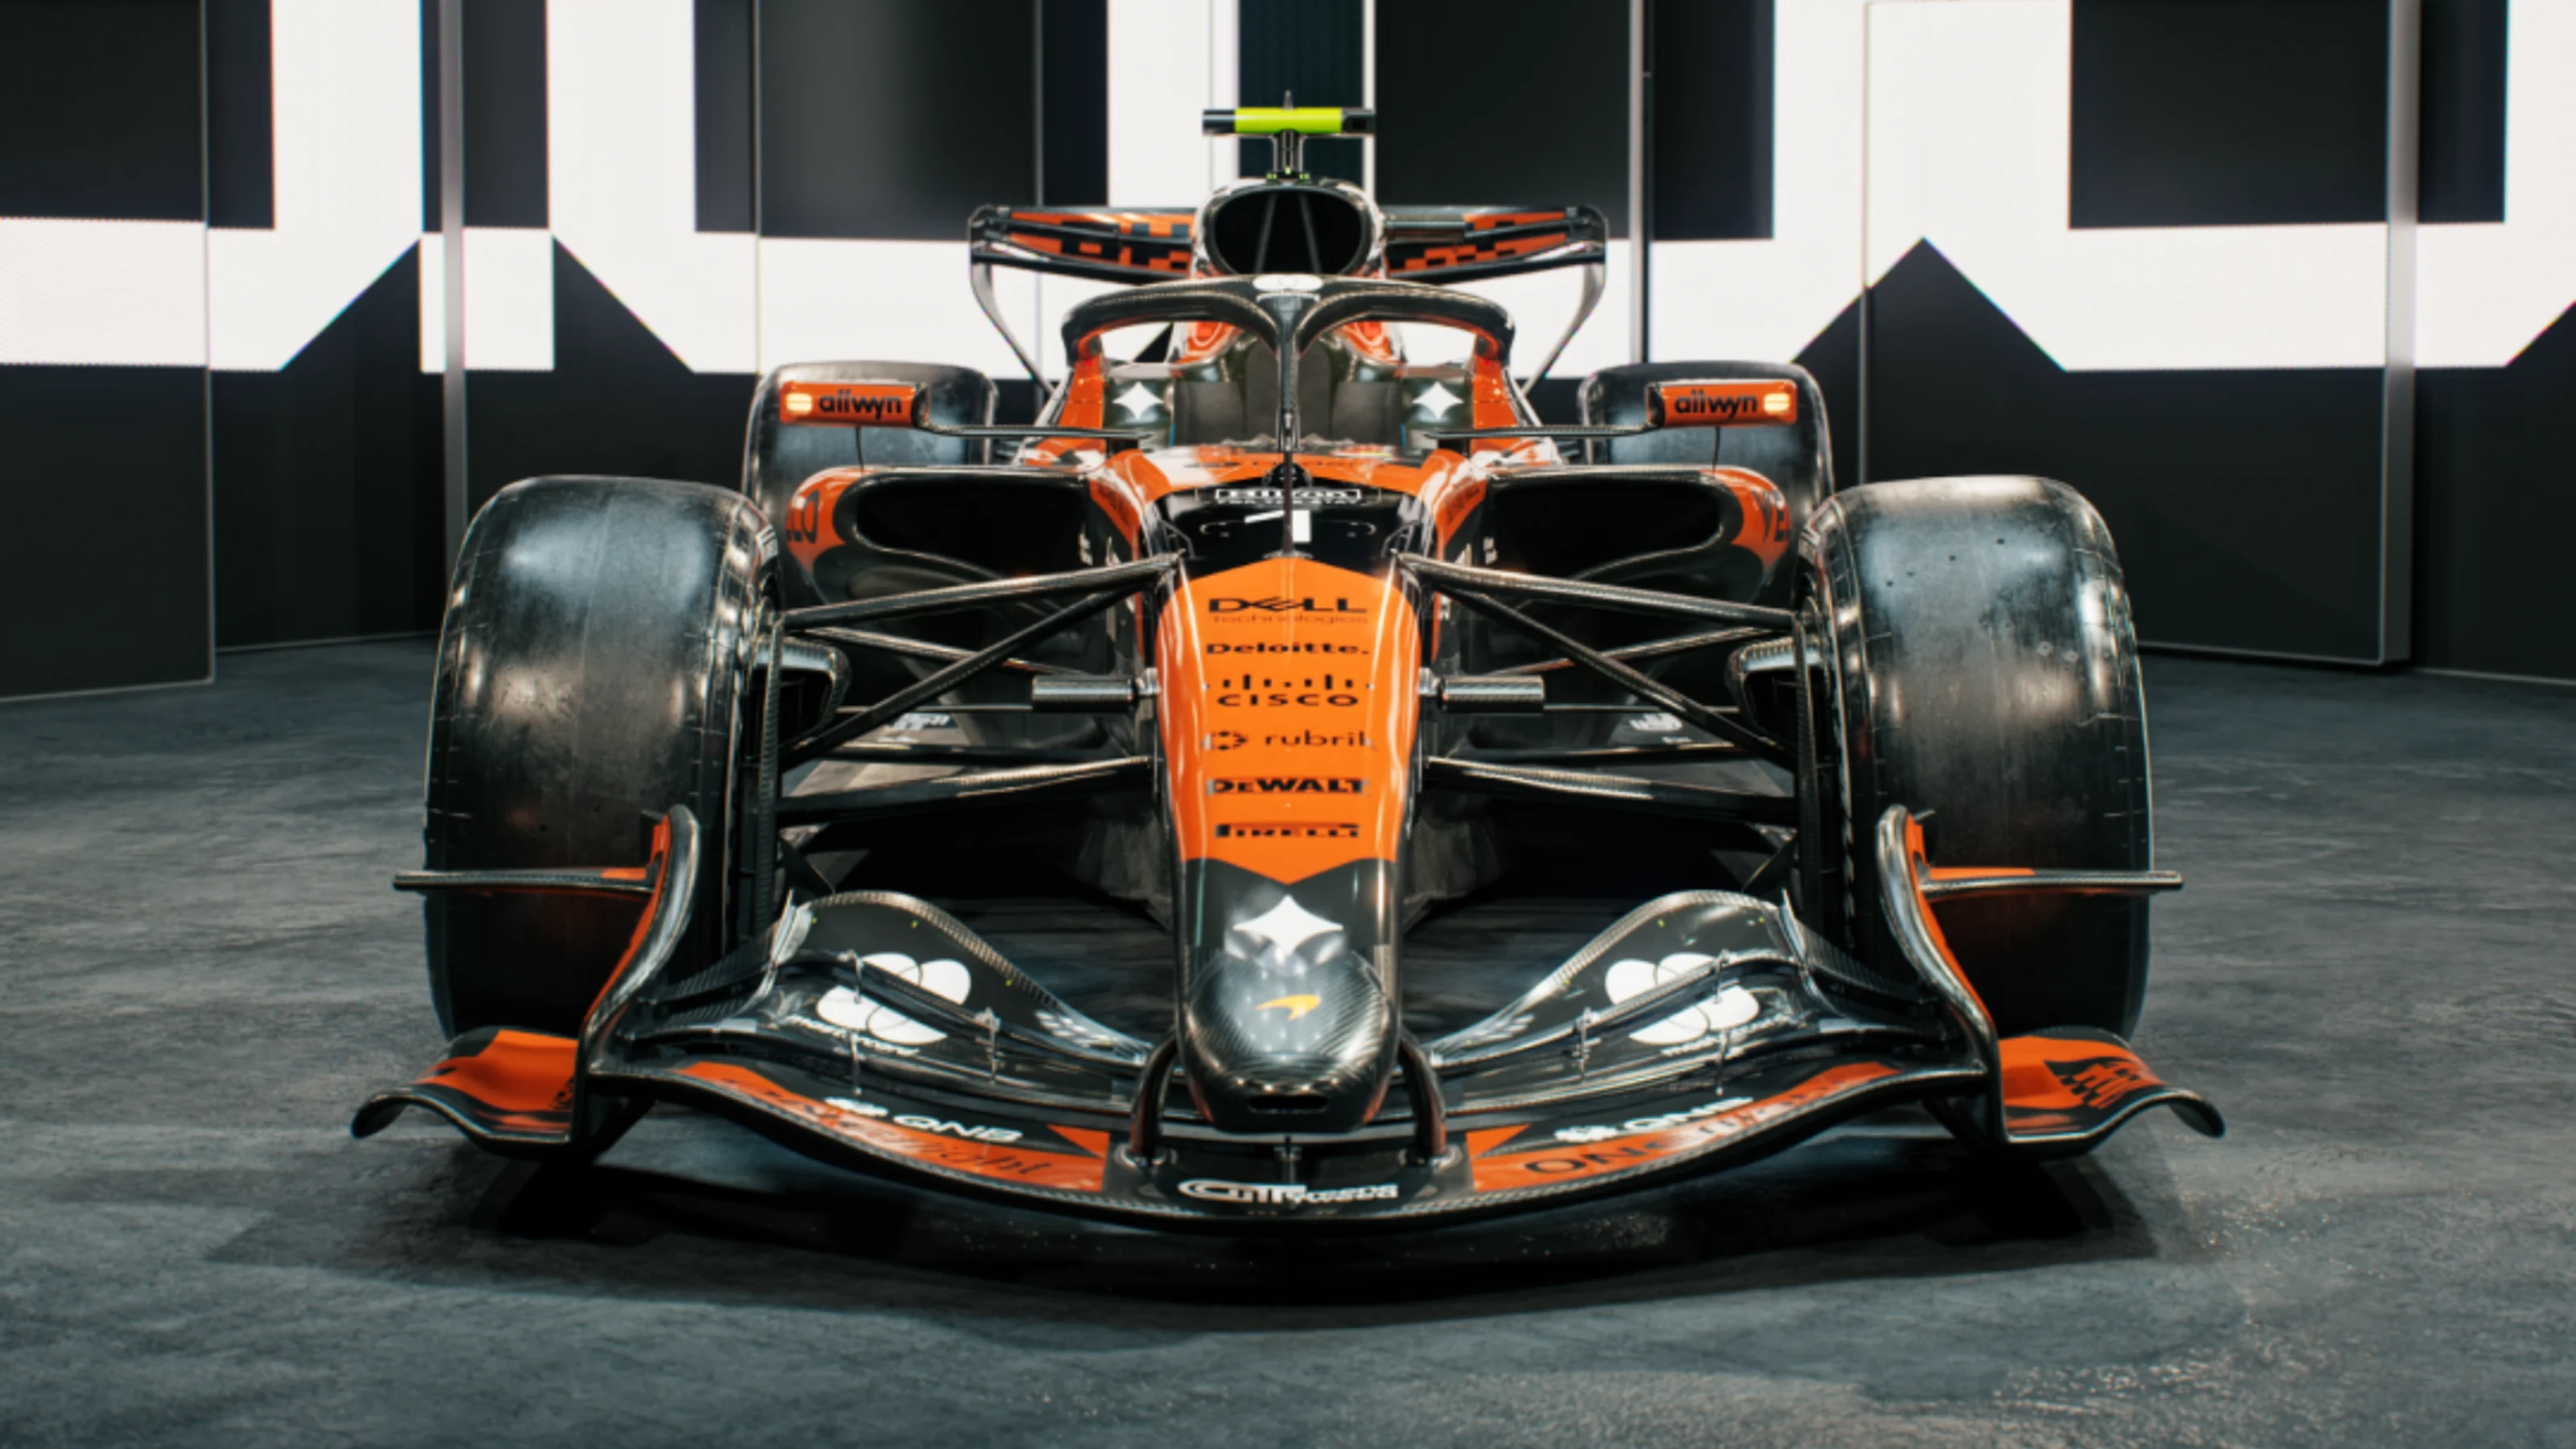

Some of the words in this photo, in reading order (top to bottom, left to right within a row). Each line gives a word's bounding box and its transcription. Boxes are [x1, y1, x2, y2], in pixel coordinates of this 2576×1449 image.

[818, 388, 902, 419] allwyn
[1674, 388, 1757, 419] allwyn
[1209, 597, 1368, 613] DELL
[1216, 694, 1359, 707] CISCO
